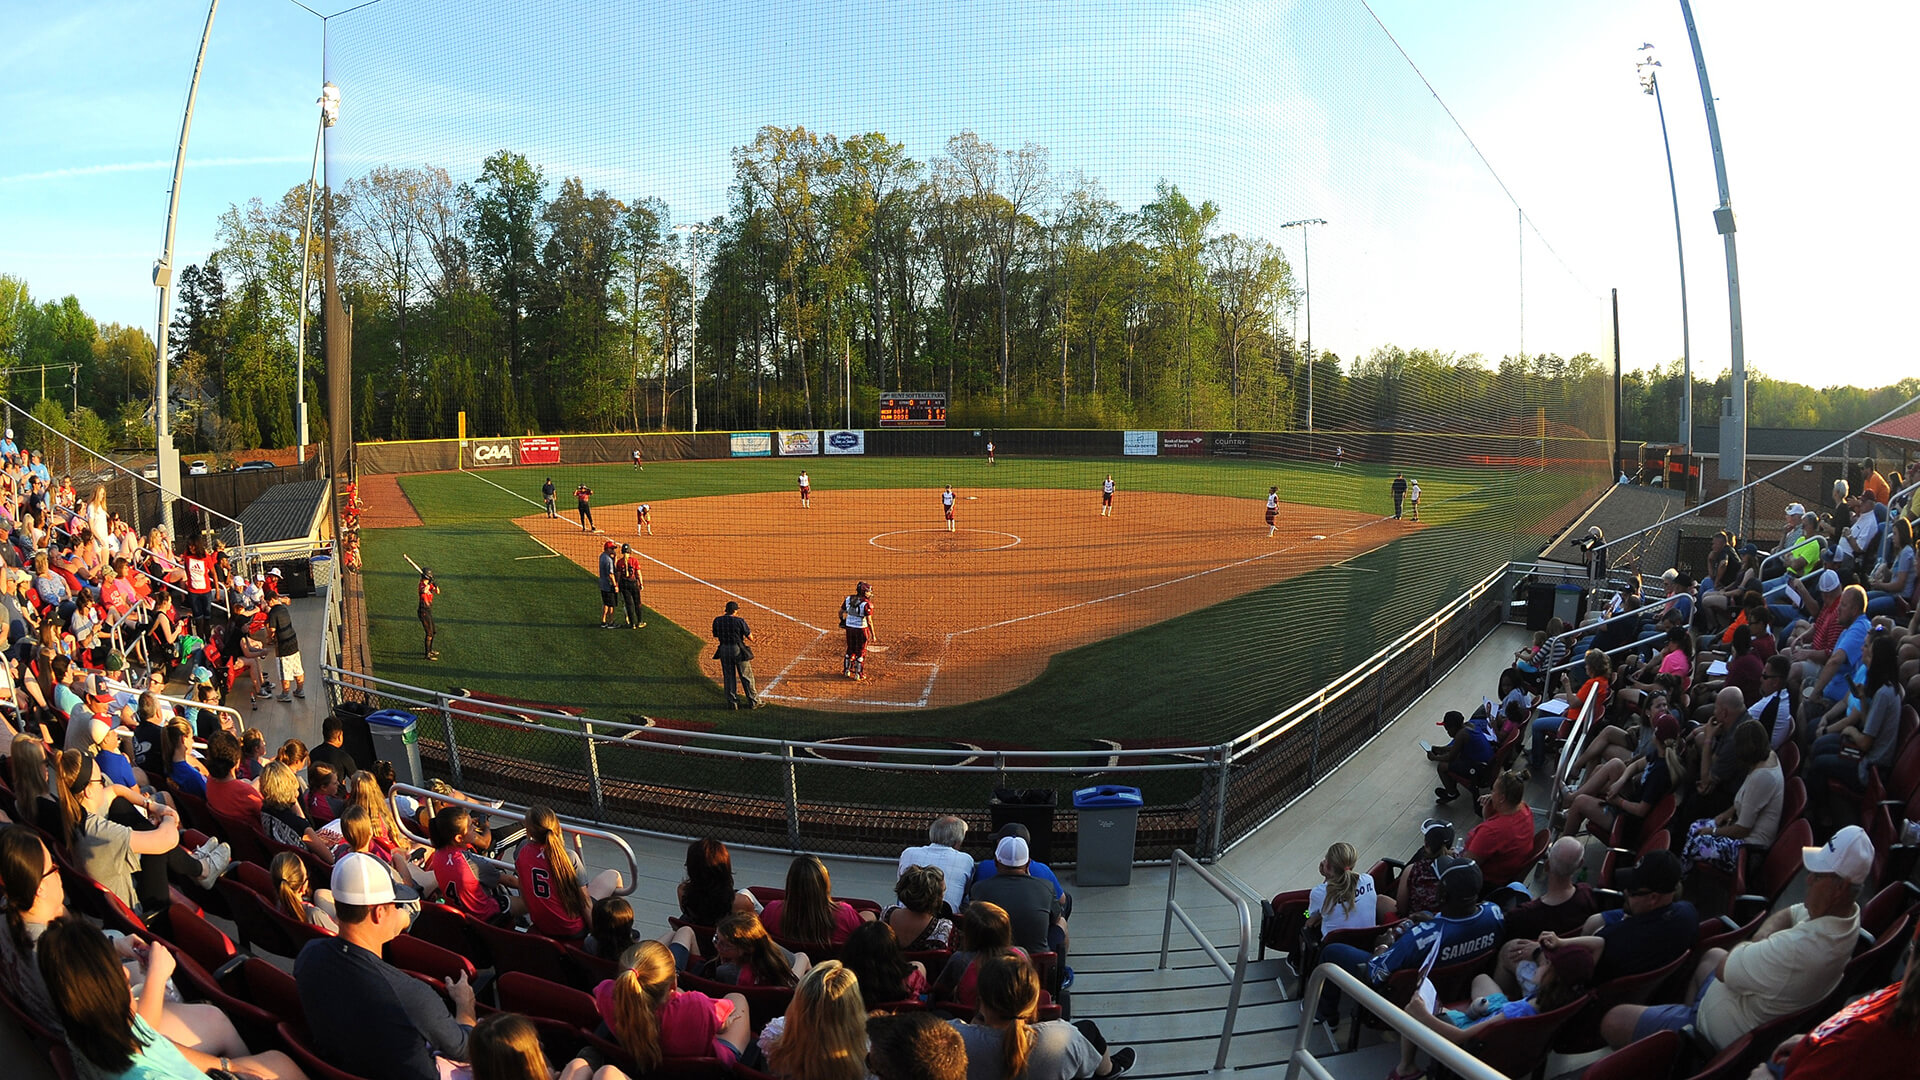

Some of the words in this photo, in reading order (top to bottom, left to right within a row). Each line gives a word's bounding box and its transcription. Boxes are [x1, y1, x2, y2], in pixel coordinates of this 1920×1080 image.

[475, 445, 512, 460] CAA
[445, 881, 460, 905] 4
[531, 867, 550, 899] 6
[1441, 932, 1496, 960] SANDERS
